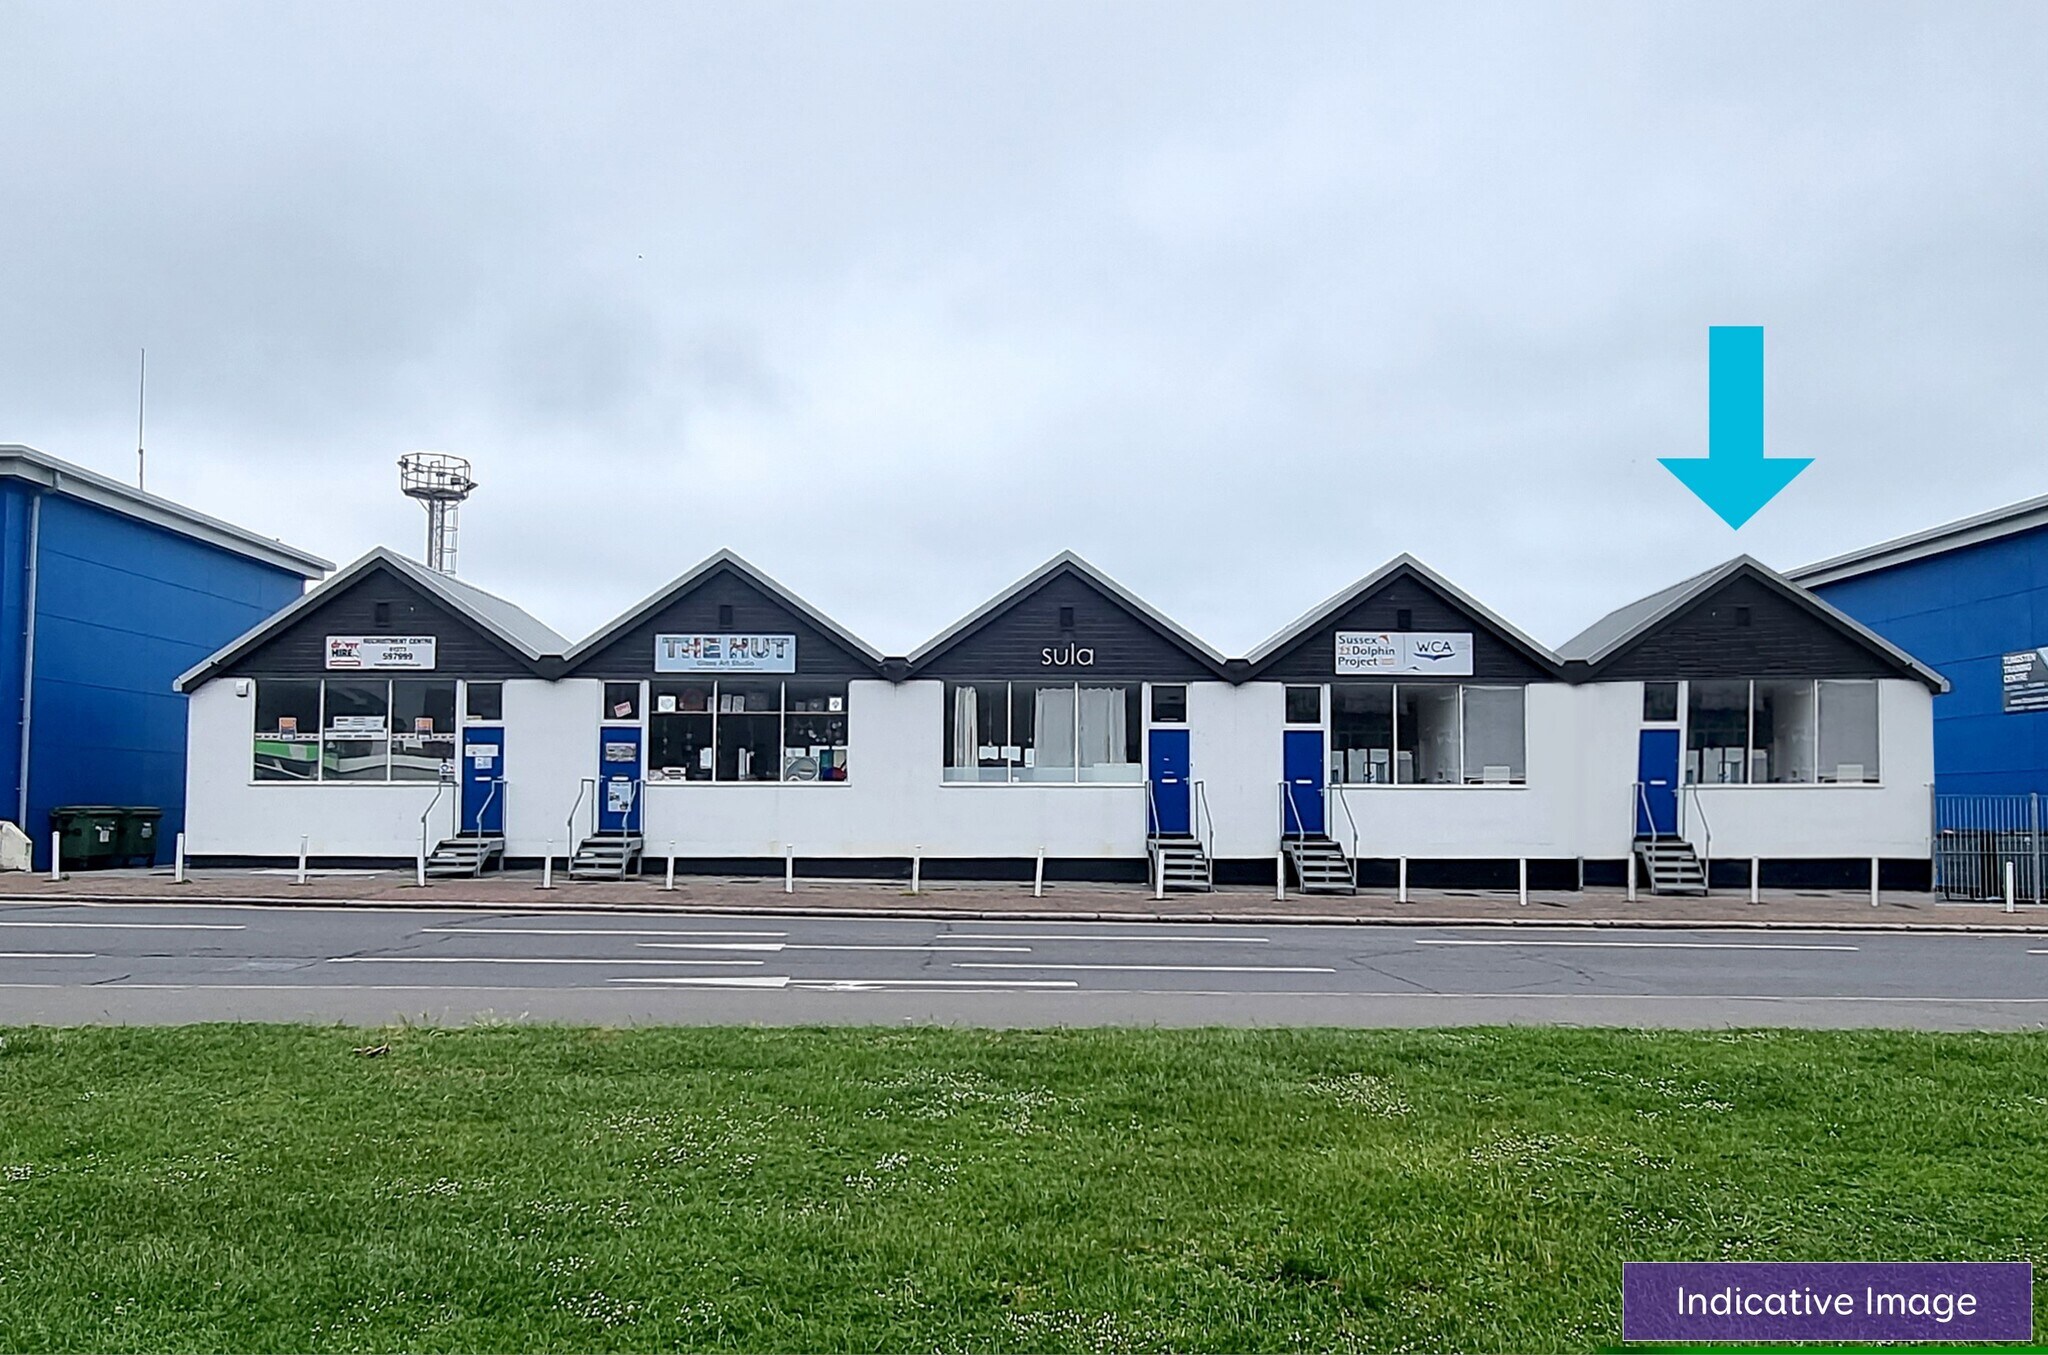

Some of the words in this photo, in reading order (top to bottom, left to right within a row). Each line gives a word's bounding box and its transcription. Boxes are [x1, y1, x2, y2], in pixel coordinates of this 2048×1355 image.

[1338, 635, 1378, 645] Sussex
[661, 637, 721, 659] THE
[729, 637, 790, 659] HUT
[1352, 646, 1395, 657] Dolphin
[1416, 641, 1453, 653] WCA
[331, 649, 353, 658] HIRE
[1041, 642, 1094, 666] sula
[1338, 657, 1378, 668] Project
